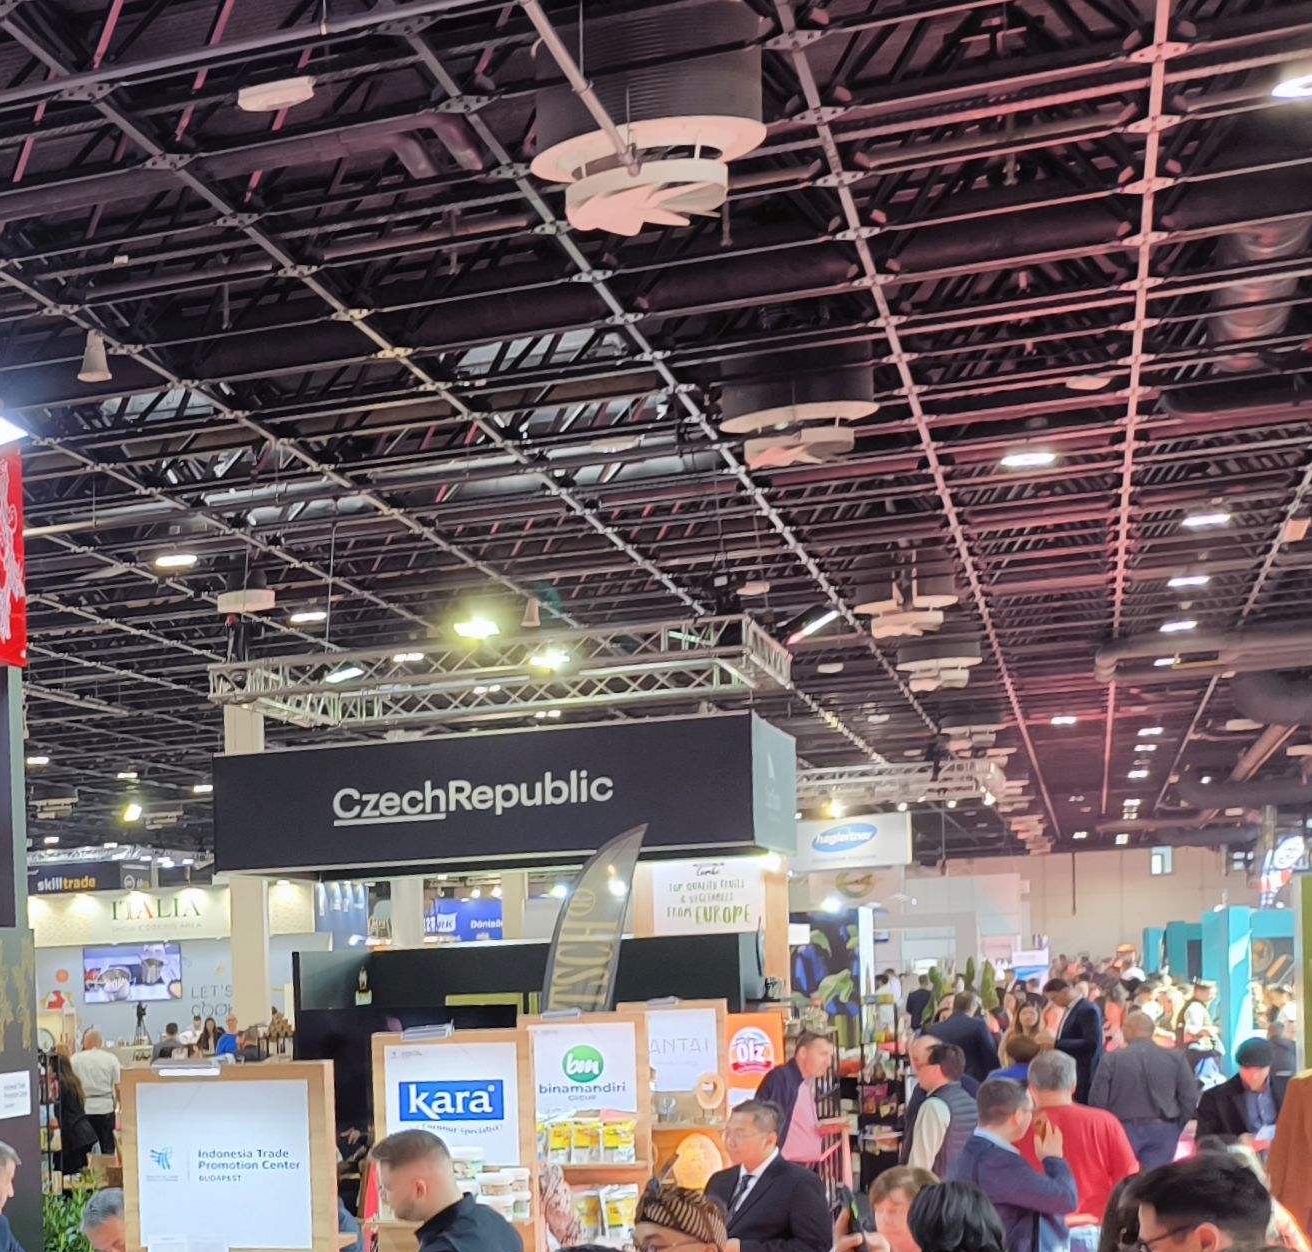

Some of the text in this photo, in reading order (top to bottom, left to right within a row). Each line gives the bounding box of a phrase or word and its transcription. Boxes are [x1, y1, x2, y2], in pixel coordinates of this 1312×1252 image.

[332, 769, 614, 820] CzechRepublic
[37, 875, 96, 892] skilltrade
[695, 904, 751, 924] EUROPE
[539, 1082, 626, 1095] binamandiri
[198, 1149, 289, 1159] Indonesia Trade
[198, 1160, 300, 1170] Promotion Center
[199, 1174, 242, 1182] BUDAPEST
